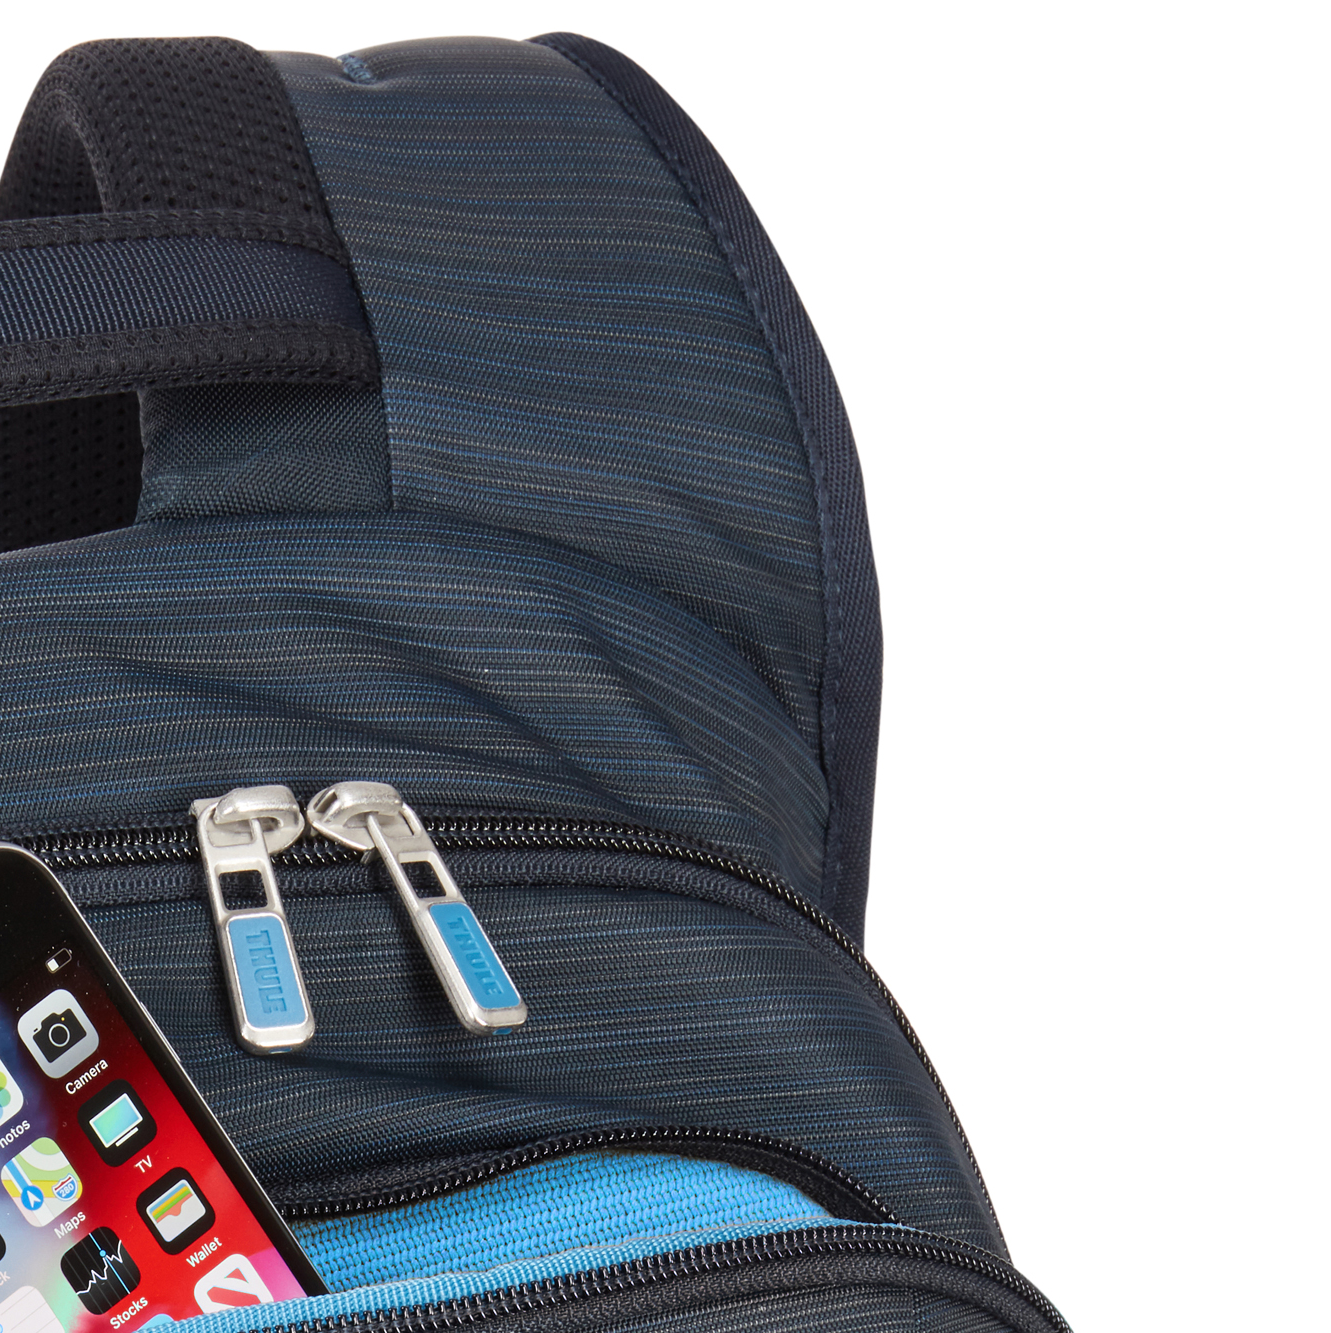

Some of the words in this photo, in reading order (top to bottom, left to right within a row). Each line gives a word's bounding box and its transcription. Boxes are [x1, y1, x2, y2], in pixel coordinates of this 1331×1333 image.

[246, 929, 287, 1014] THULE
[447, 917, 504, 997] THULE
[65, 1058, 109, 1094] Camera
[134, 1155, 153, 1174] TV
[59, 1183, 74, 1198] 280
[54, 1211, 86, 1240] Maps
[186, 1236, 223, 1268] Wallet
[109, 1296, 149, 1330] Stocks
